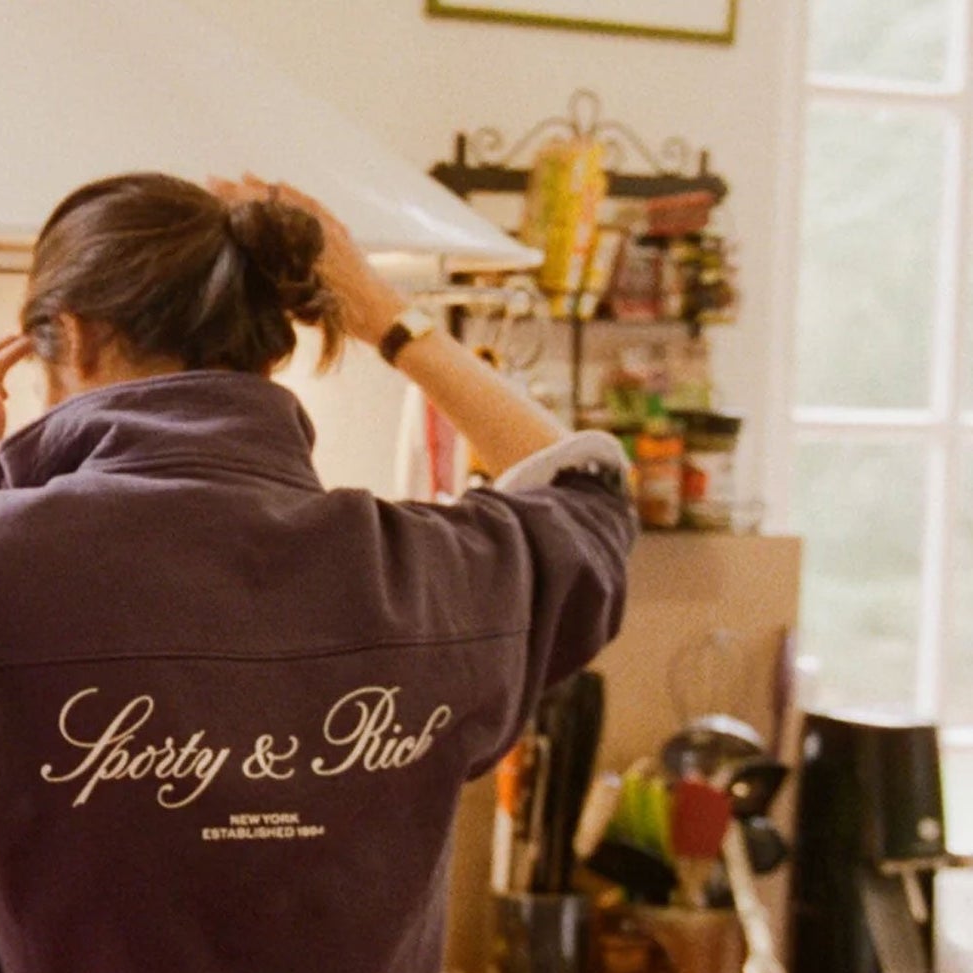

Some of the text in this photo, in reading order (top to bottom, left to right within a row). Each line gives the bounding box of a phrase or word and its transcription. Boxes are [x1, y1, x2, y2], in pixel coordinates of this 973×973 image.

[40, 686, 451, 807] Sporty & Rich
[230, 813, 300, 826] NEW YORK
[202, 826, 294, 840] ESTABLISHED
